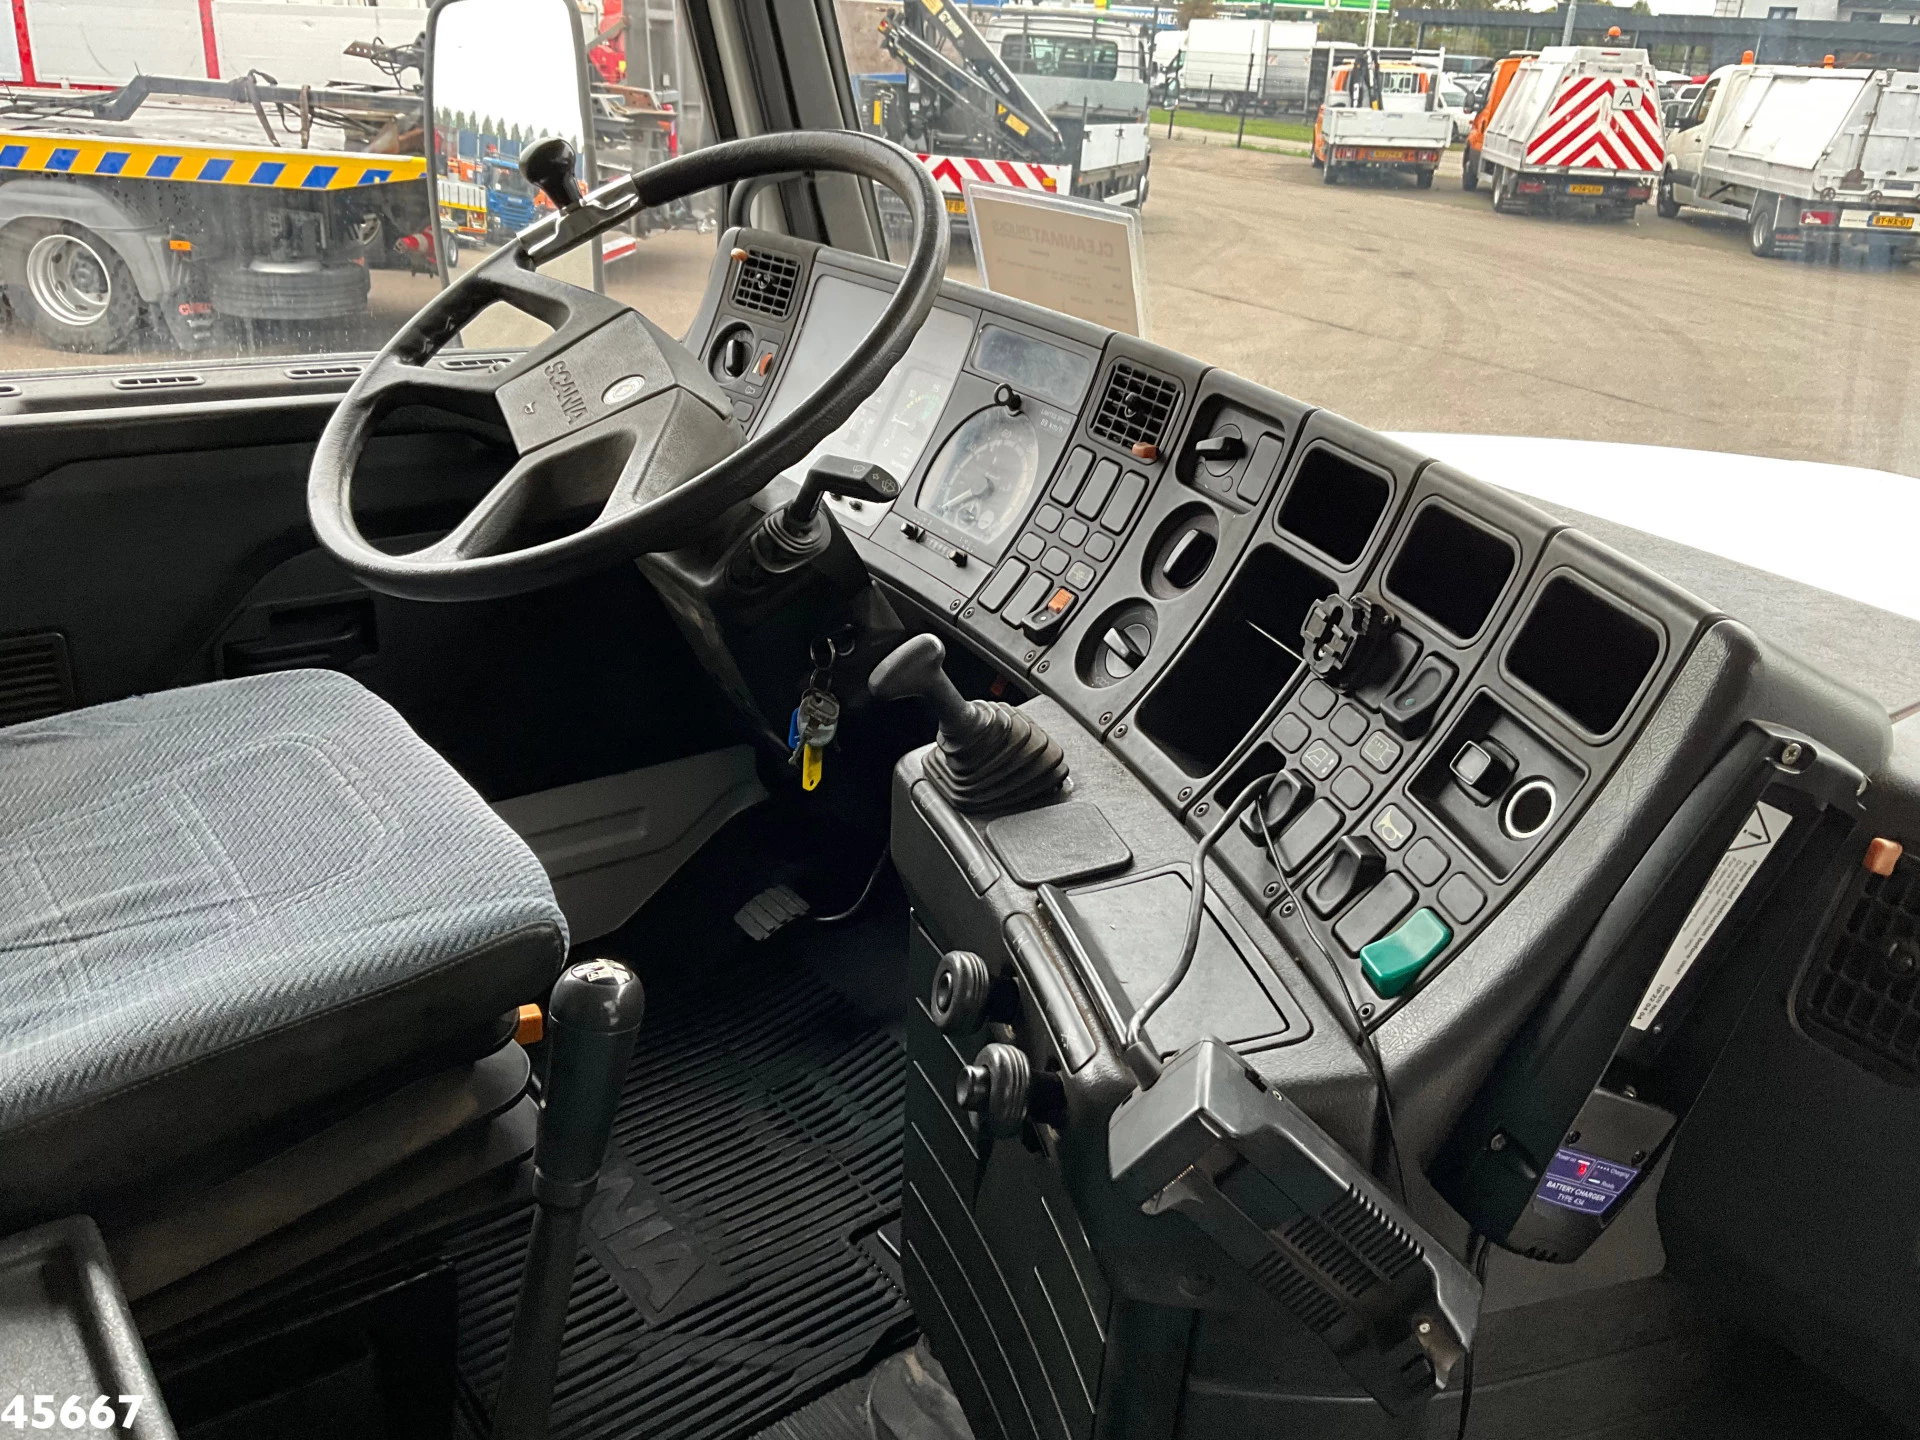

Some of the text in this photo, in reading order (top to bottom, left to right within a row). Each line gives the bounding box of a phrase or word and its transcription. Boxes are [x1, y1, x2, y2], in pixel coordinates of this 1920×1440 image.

[1619, 90, 1634, 107] A
[544, 362, 588, 425] SCANIA
[1546, 1180, 1606, 1202] BATTERY CHARGER
[1557, 1193, 1573, 1204] TYPE
